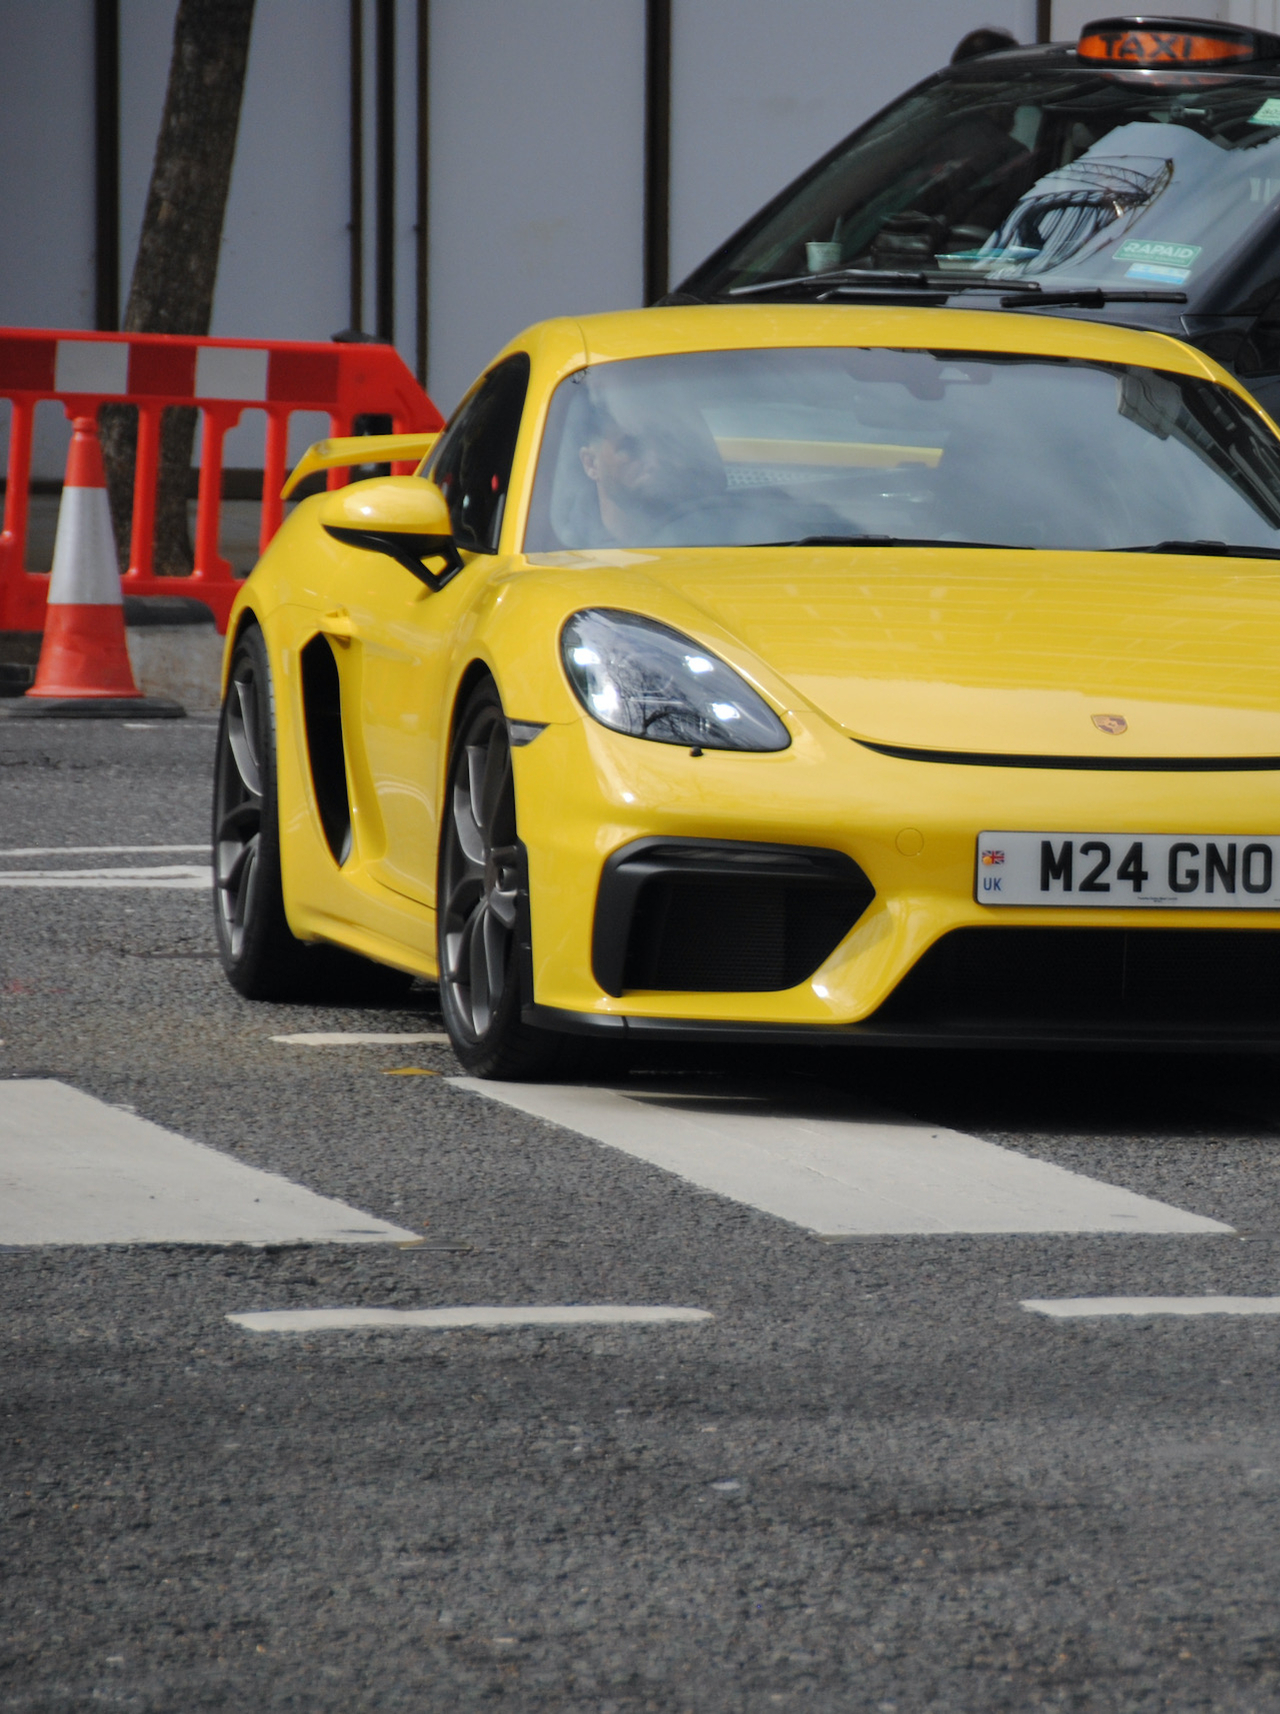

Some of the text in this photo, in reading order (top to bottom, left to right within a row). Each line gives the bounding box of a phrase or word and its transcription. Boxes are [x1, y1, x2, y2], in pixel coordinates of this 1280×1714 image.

[1098, 32, 1193, 59] TAXI
[1123, 242, 1194, 258] RAPAID
[1040, 840, 1273, 894] M24 GNO
[983, 877, 1002, 891] UK
